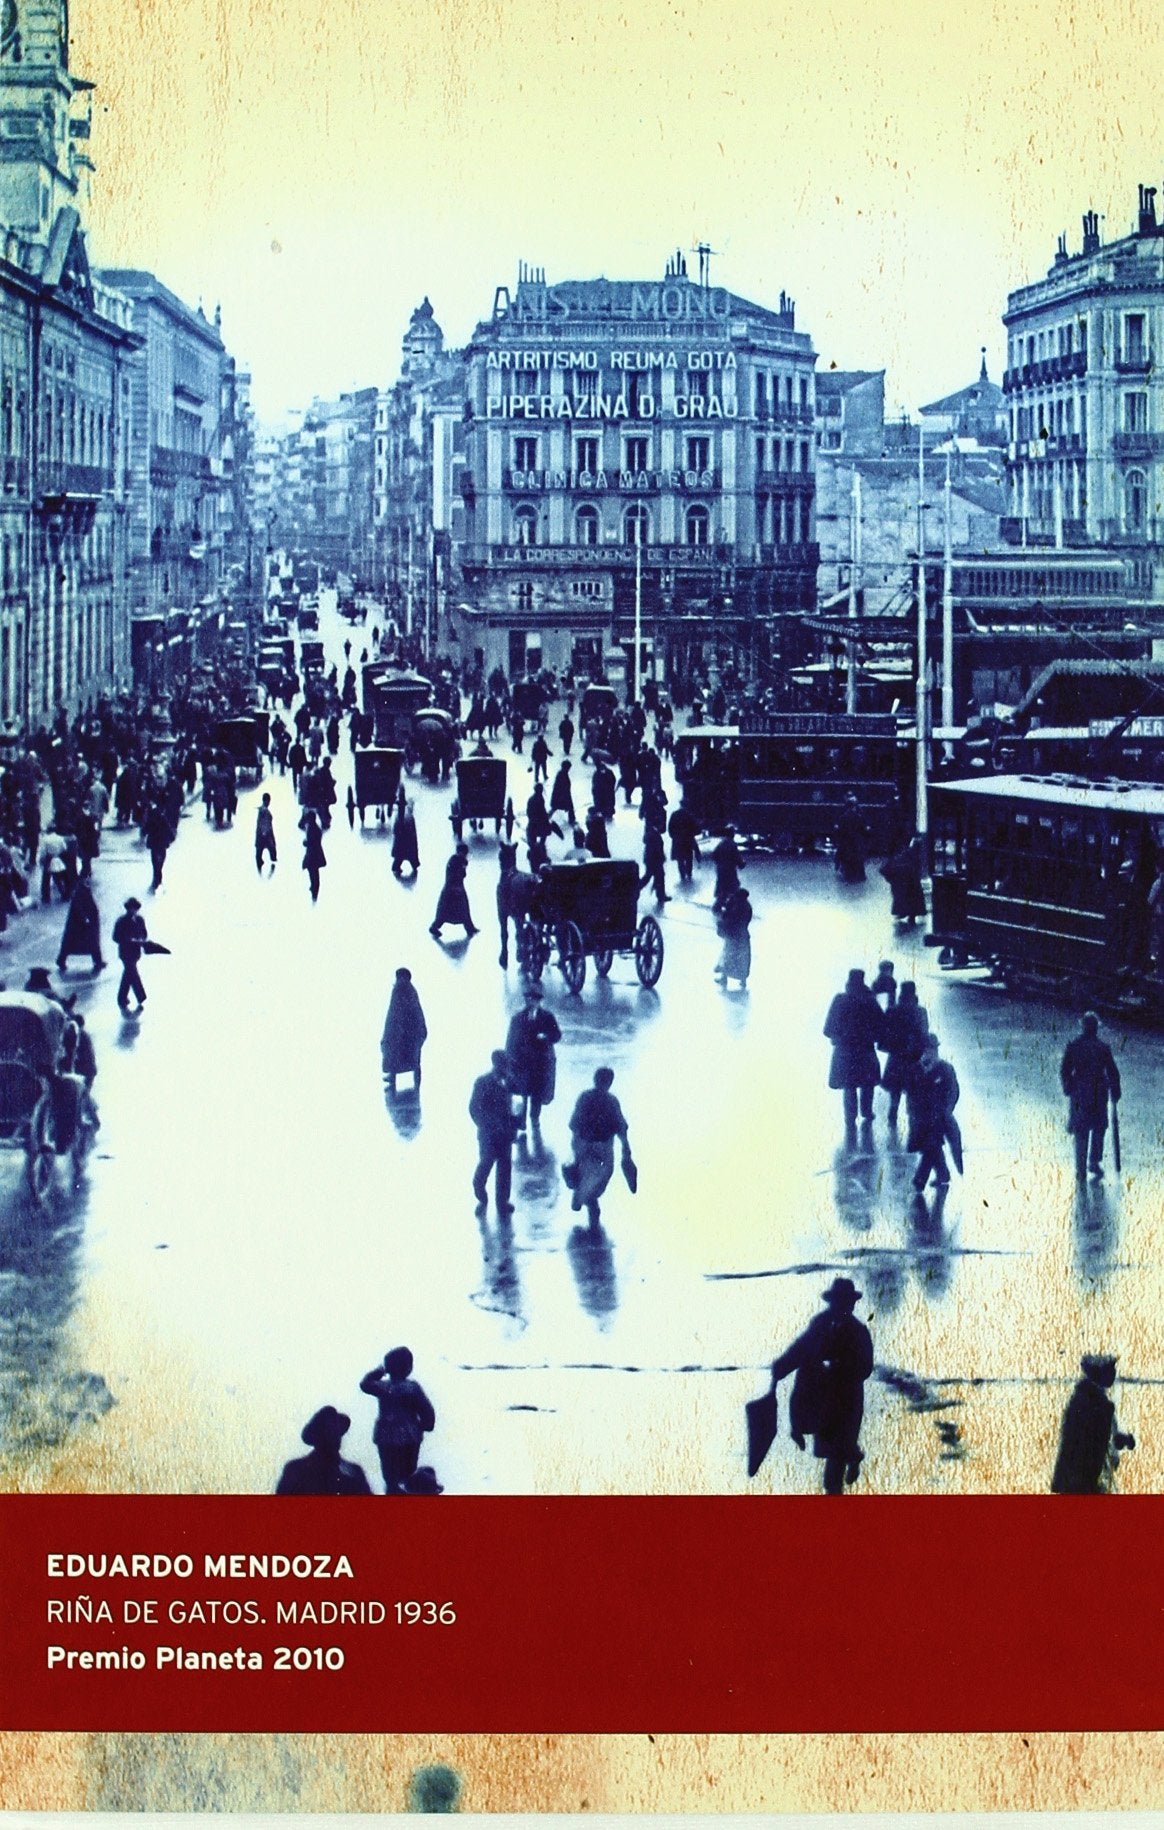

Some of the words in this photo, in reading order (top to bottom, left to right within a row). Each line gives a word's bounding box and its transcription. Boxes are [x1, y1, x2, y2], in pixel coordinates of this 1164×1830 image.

[631, 286, 731, 320] MONO
[486, 351, 598, 370] ARTRITISMO
[611, 351, 678, 370] REUMA
[688, 351, 738, 370] GOTA
[487, 395, 629, 418] PIPERAZINA
[674, 395, 739, 418] GRAU
[512, 471, 609, 489] CLINICA
[618, 471, 714, 489] MATEOS
[47, 1554, 194, 1578] EDUARDO
[204, 1554, 354, 1578] MENDOZA
[47, 1595, 113, 1624] RIÑA
[124, 1600, 159, 1624] DE
[168, 1600, 266, 1624] GATOS.
[276, 1600, 386, 1624] MADRID
[394, 1600, 457, 1624] 1936
[47, 1646, 146, 1671] Premio
[156, 1646, 263, 1671] Planeta
[273, 1646, 345, 1671] 2010
